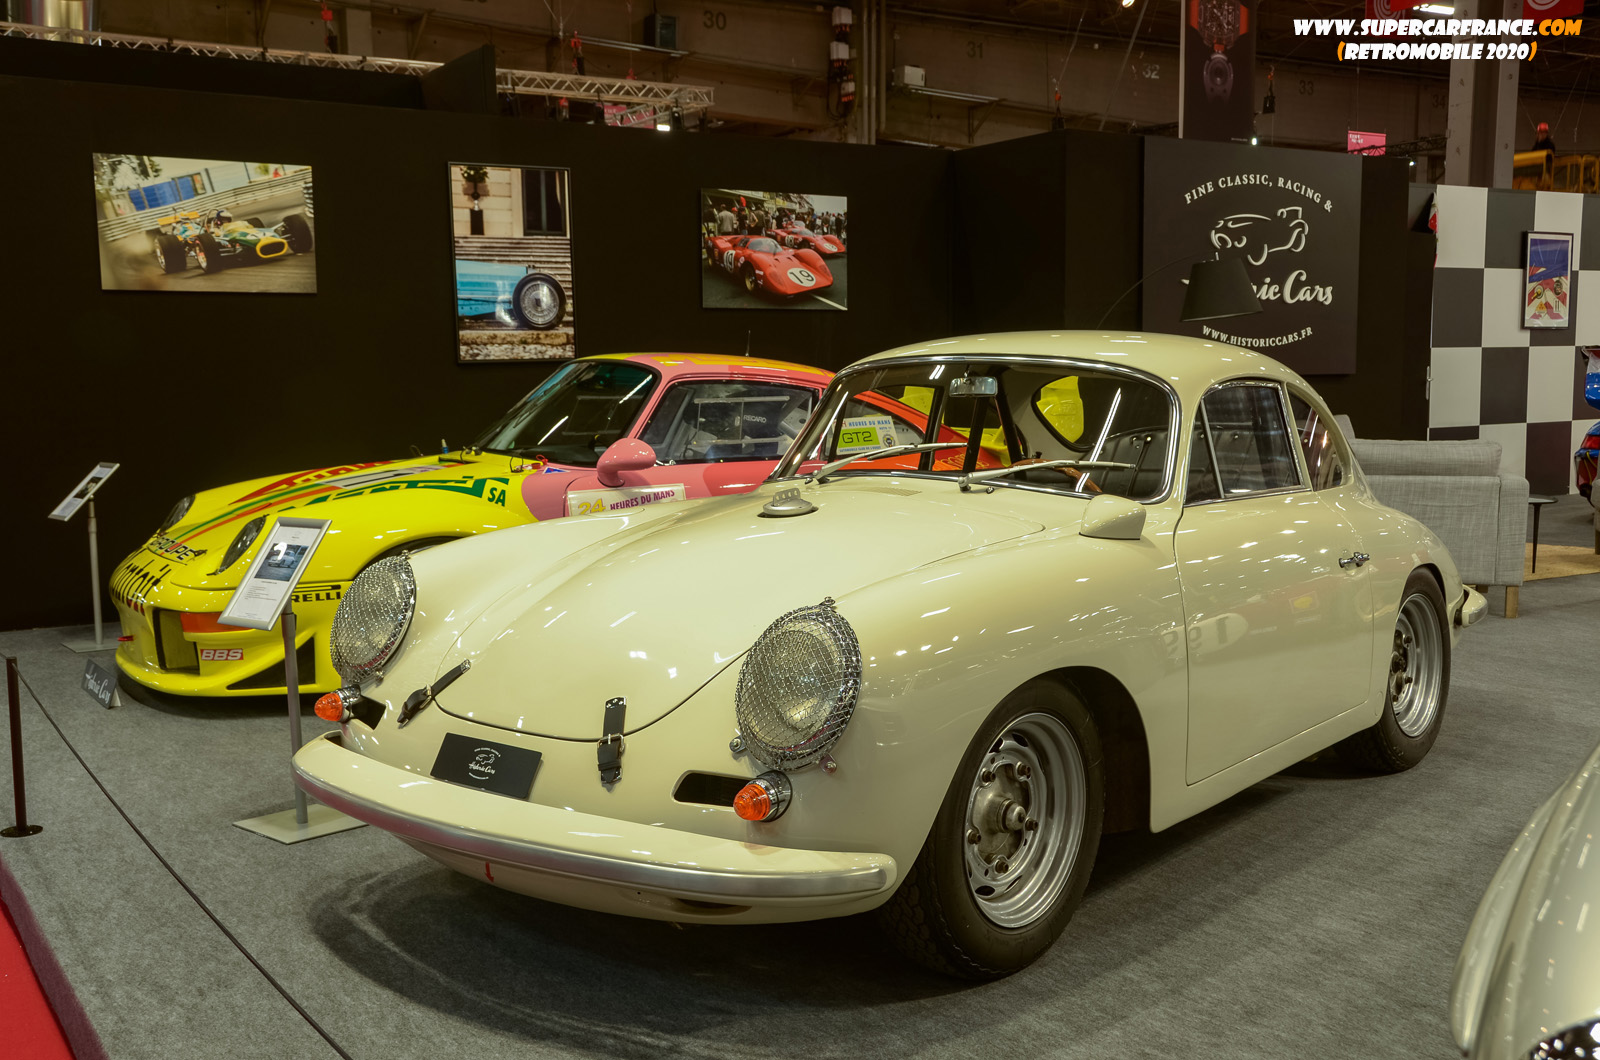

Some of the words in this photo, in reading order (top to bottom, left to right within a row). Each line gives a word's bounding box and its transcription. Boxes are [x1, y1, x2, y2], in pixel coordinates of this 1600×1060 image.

[703, 12, 727, 30] 30
[966, 41, 984, 59] 31
[1141, 62, 1161, 79] 32
[1298, 79, 1315, 96] 33
[1184, 181, 1214, 204] FINE
[1218, 174, 1273, 188] CLASSIC,
[1277, 177, 1322, 203] RACING
[1324, 200, 1333, 212] &
[789, 269, 815, 284] 19
[1283, 270, 1333, 305] Cars
[1202, 325, 1313, 347] WWW.HISTORICCARS.FR
[743, 414, 767, 423] RECARO
[842, 431, 873, 444] GT2
[487, 486, 507, 507] SA
[578, 498, 606, 515] 24
[609, 498, 639, 510] HEURES
[641, 495, 652, 505] DU
[653, 489, 675, 500] MANS
[201, 649, 243, 661] BBS
